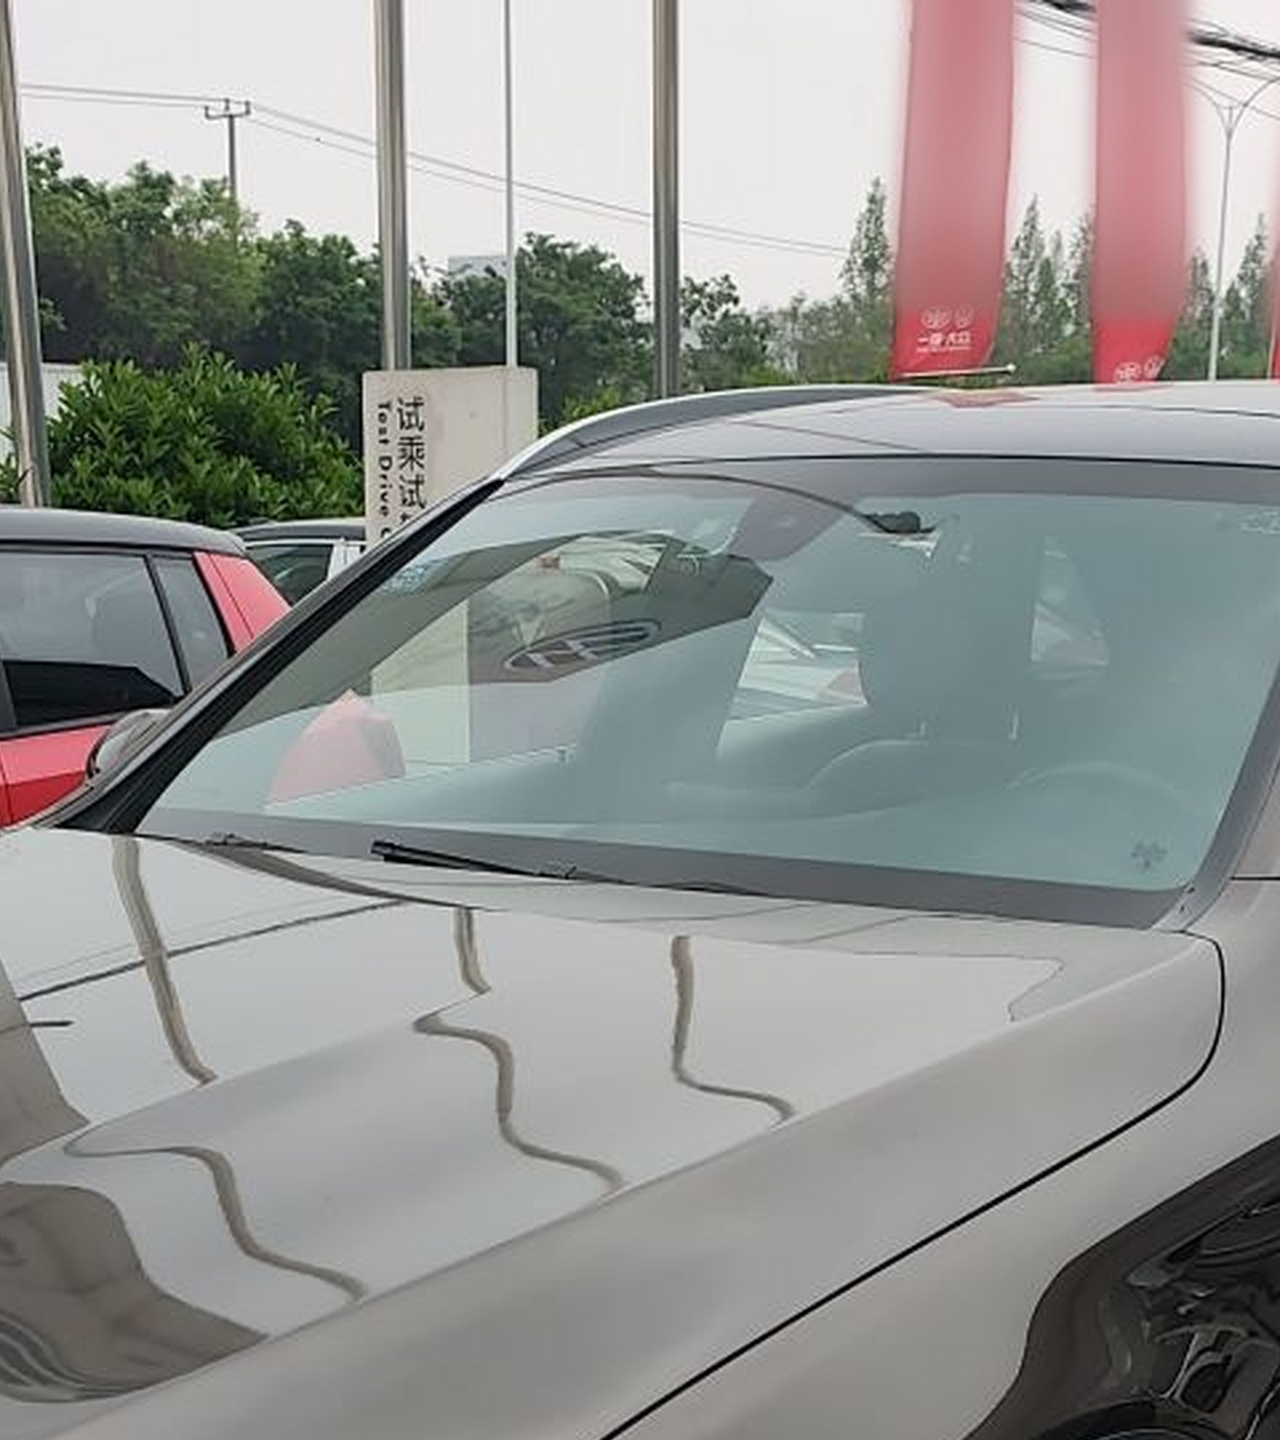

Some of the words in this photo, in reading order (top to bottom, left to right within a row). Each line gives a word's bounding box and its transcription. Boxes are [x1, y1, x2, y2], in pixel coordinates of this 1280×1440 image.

[378, 401, 392, 444] Test
[378, 455, 393, 517] Drive
[397, 396, 425, 523] 试乘试
